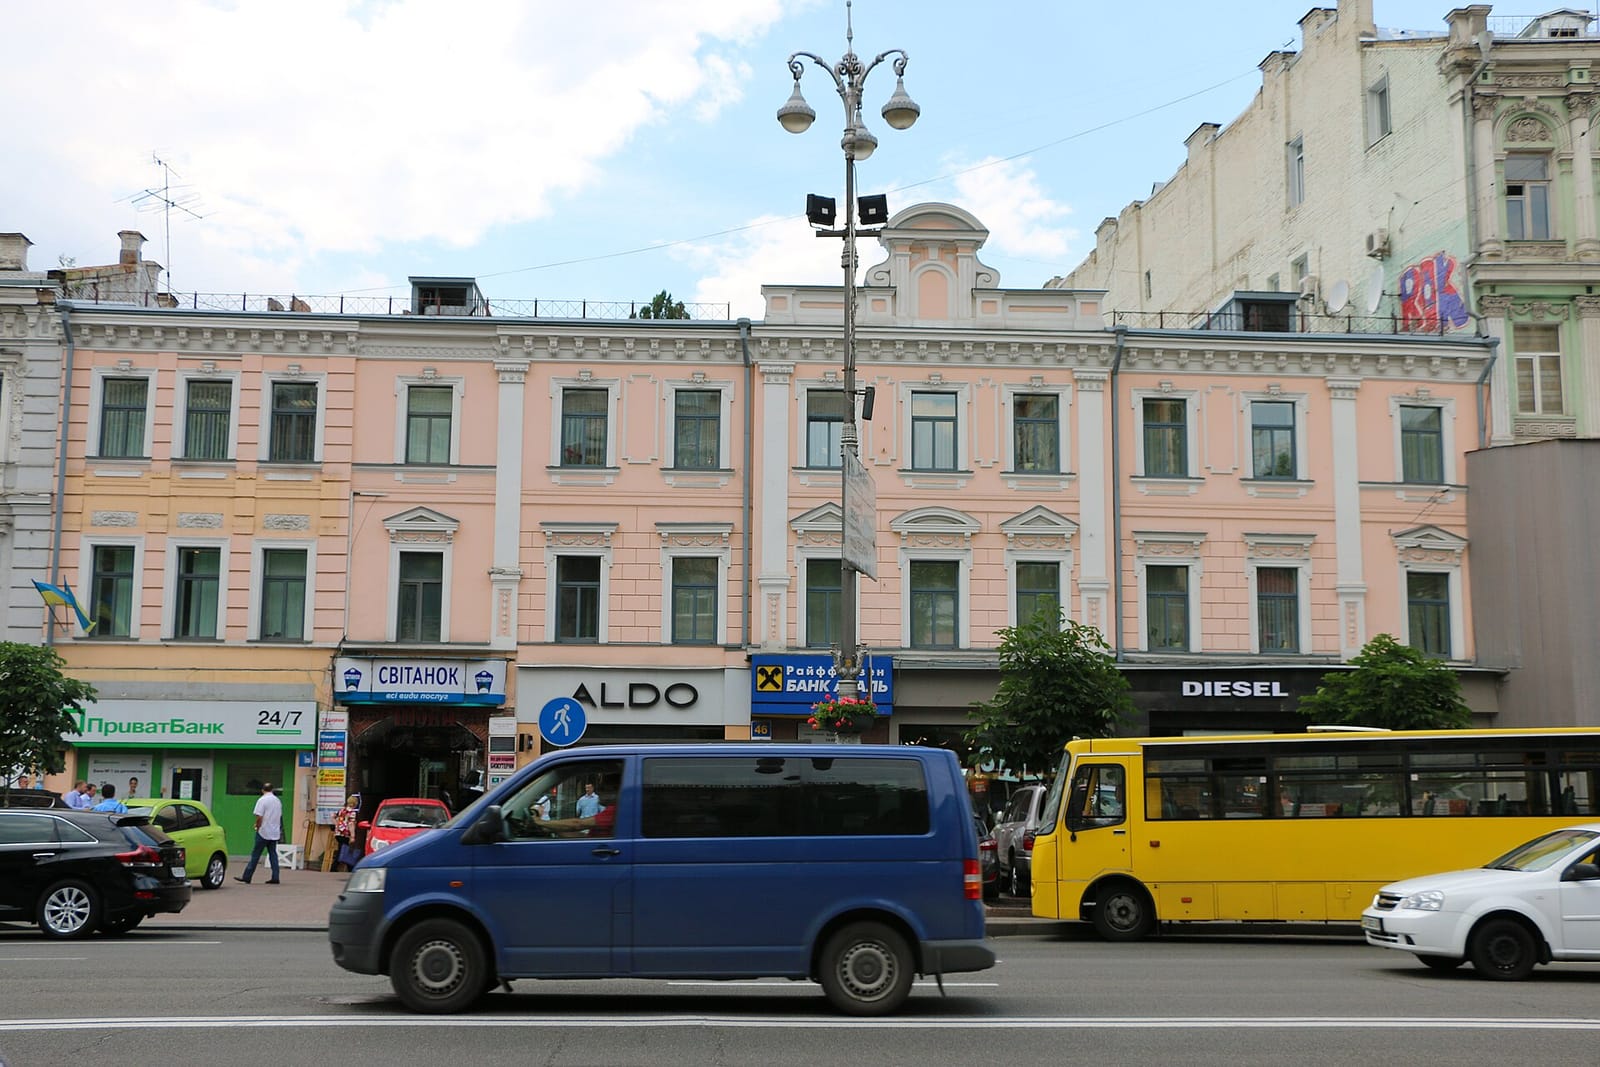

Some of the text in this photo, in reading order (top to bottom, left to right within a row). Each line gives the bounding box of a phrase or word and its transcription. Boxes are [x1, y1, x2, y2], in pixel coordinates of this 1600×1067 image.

[378, 666, 459, 686] СВІТАНОК
[786, 665, 885, 678] Райффзн
[786, 679, 889, 693] БАНК ААЛЬ
[1182, 681, 1289, 697] DIESEL
[398, 692, 419, 700] види
[420, 693, 449, 701] послуг
[572, 682, 699, 709] ALDO
[87, 717, 225, 737] ПриватБанк
[258, 710, 303, 729] 24/7
[754, 724, 768, 735] 46
